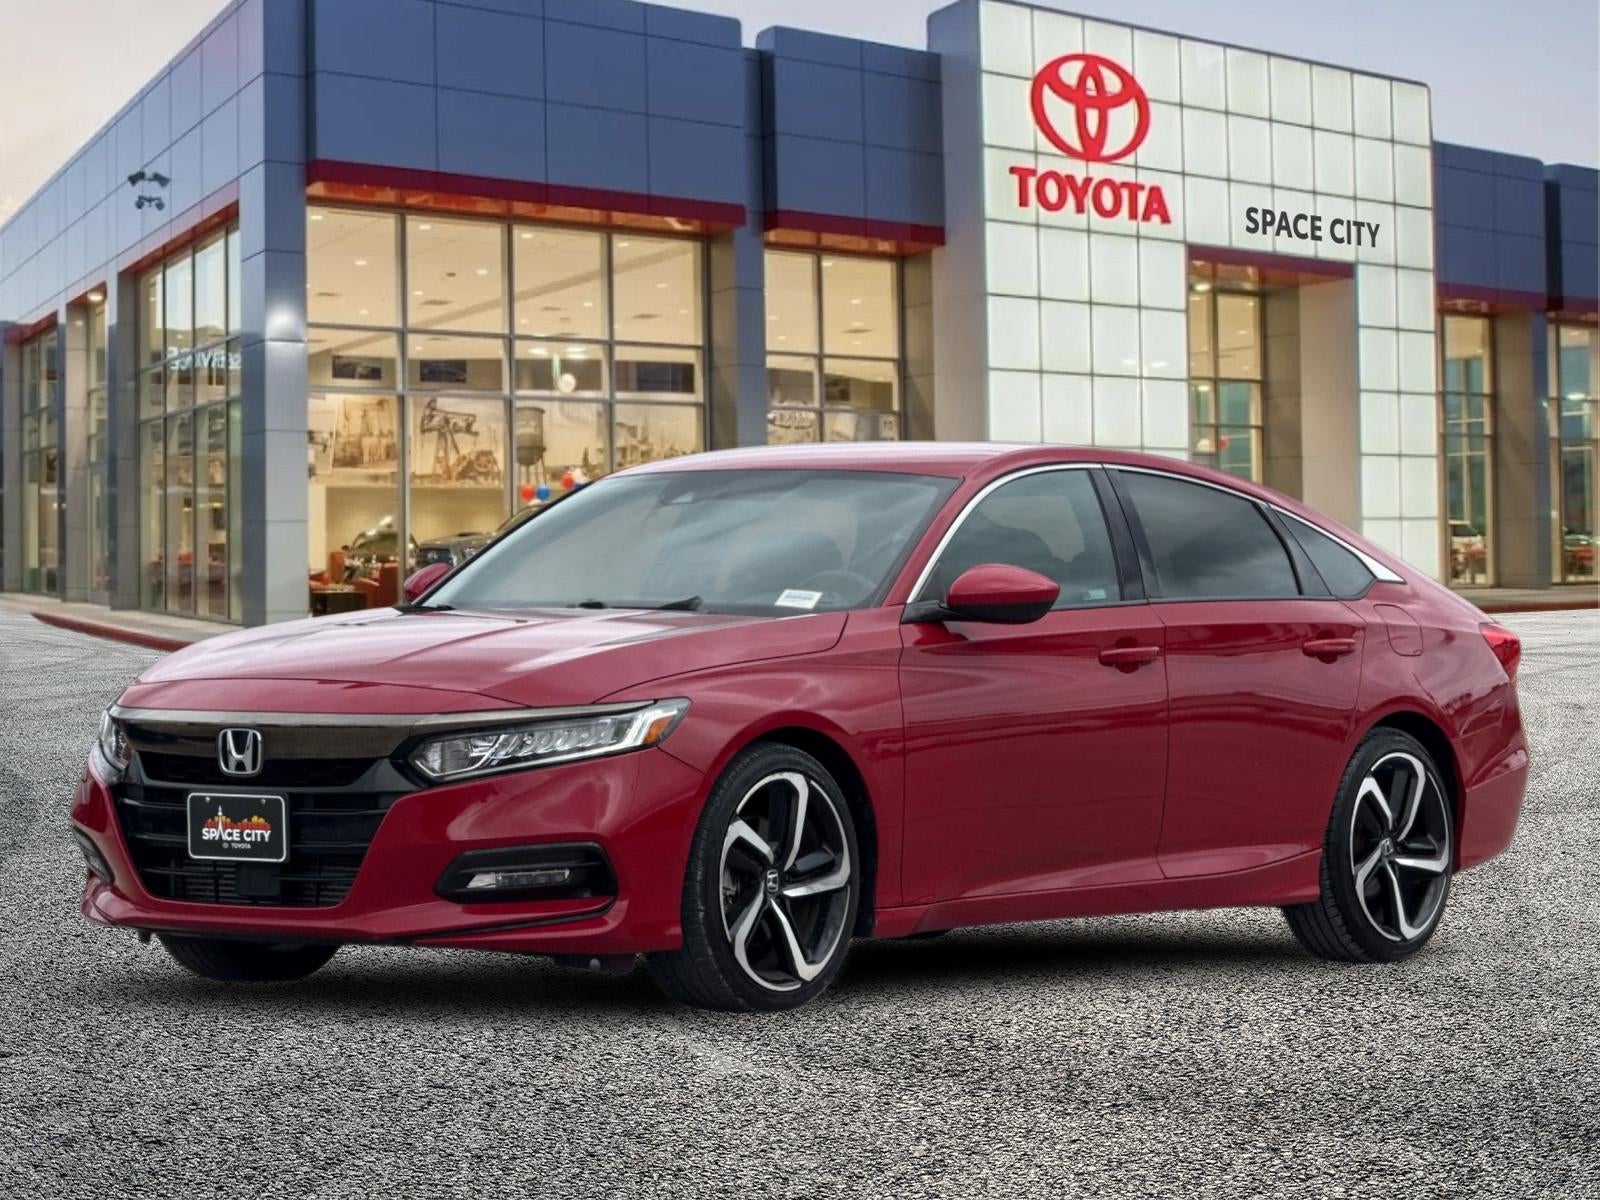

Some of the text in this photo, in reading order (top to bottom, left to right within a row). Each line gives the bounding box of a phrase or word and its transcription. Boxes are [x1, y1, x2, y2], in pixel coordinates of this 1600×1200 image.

[1009, 166, 1171, 224] TOYOTA
[1245, 206, 1381, 248] SPACE CITY
[201, 827, 271, 842] SPACE CITY
